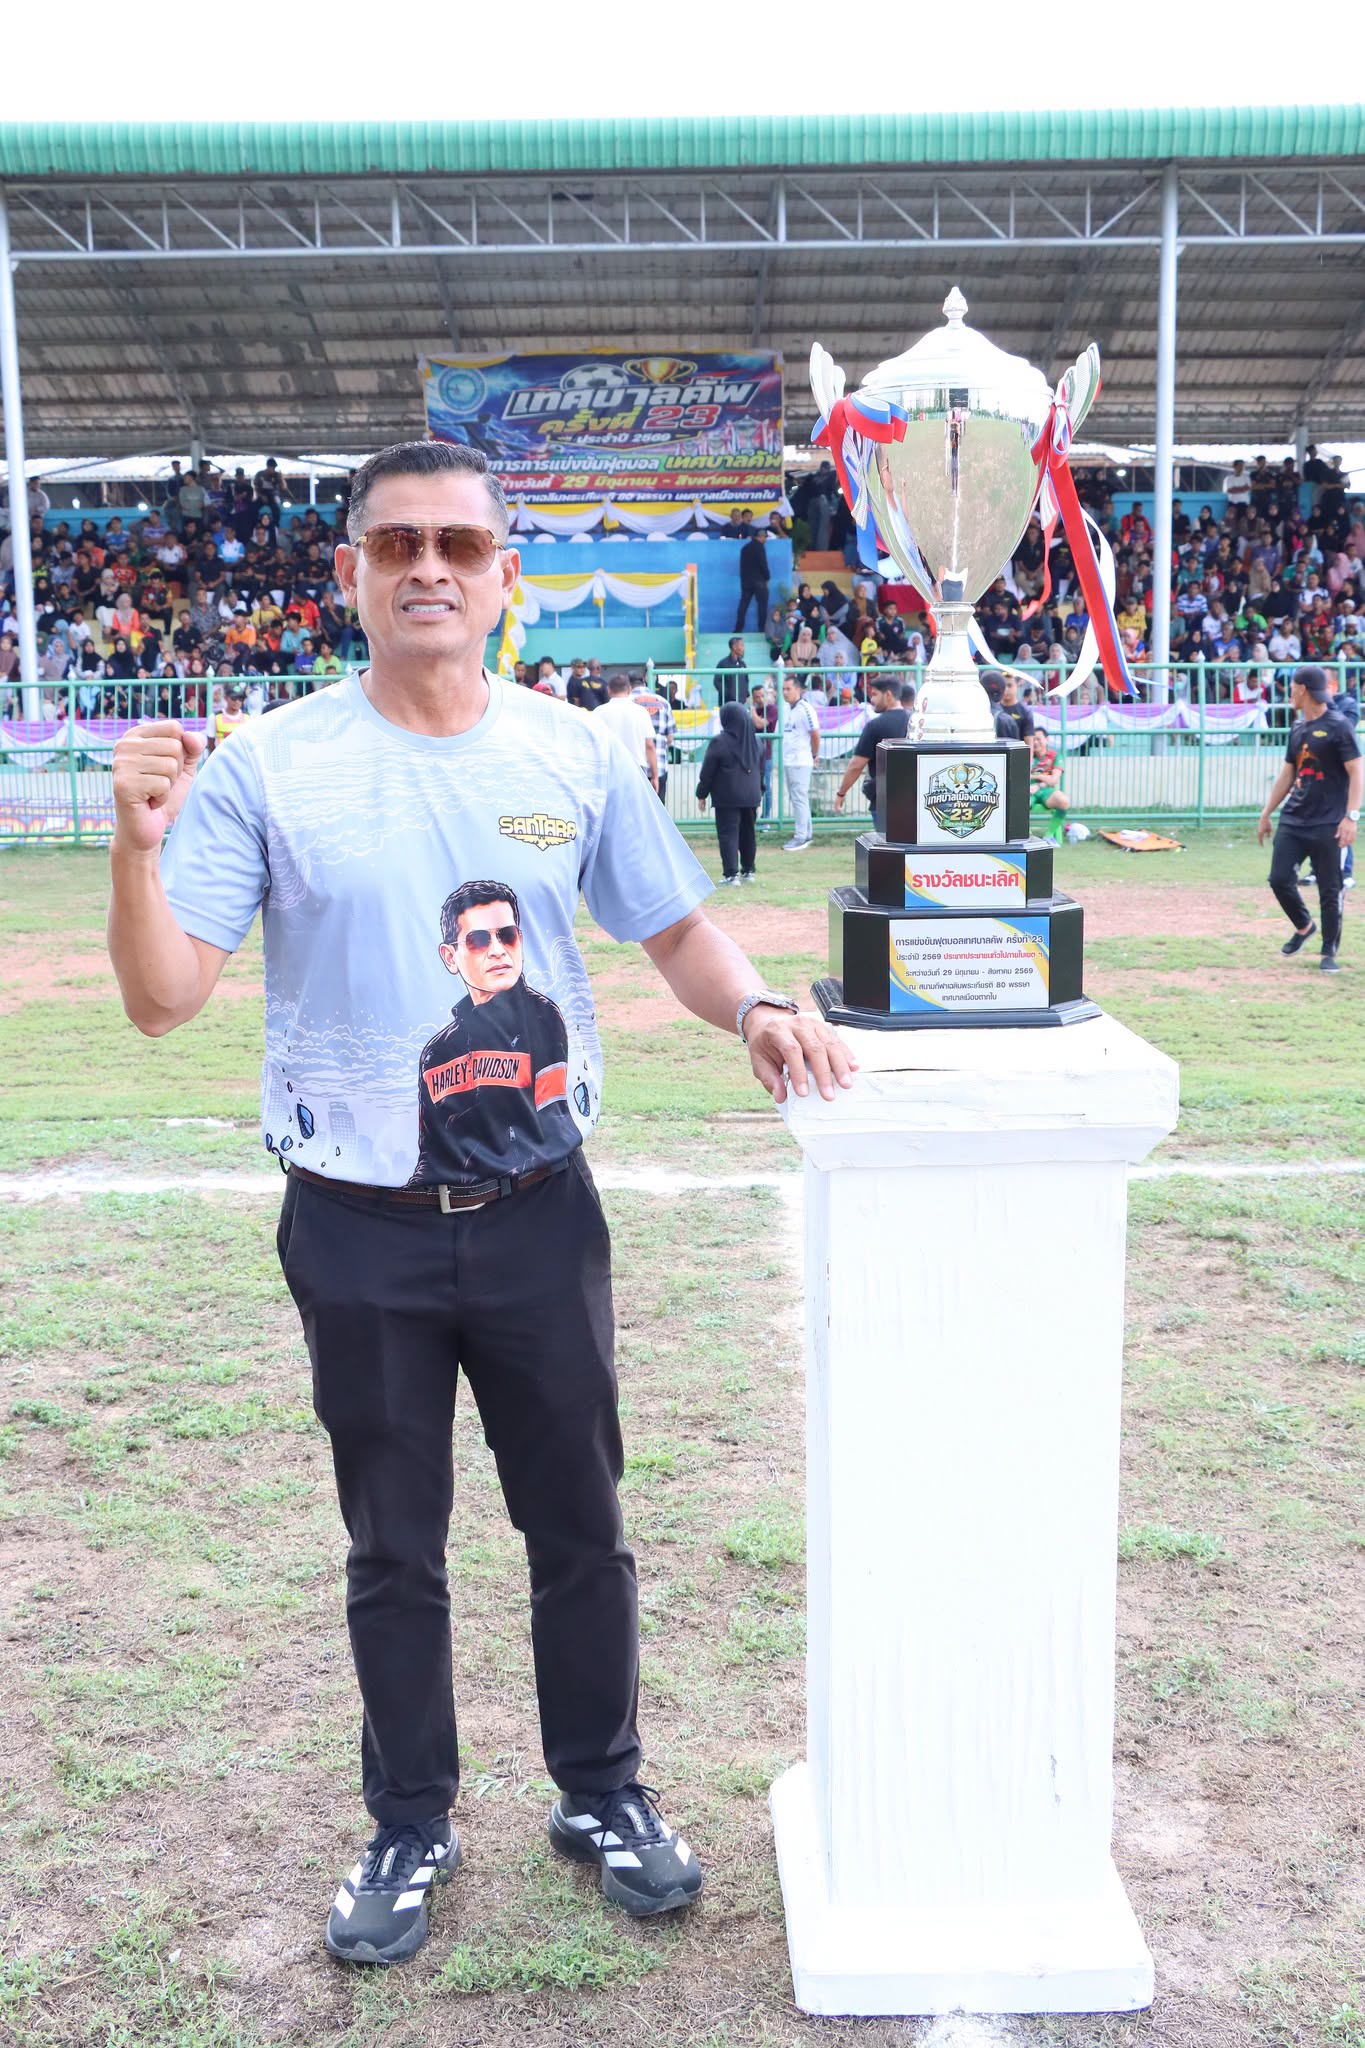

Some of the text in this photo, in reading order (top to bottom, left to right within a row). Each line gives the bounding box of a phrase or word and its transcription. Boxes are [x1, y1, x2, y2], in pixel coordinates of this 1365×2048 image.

[511, 377, 753, 414] เทศบาลคัพ
[537, 405, 721, 434] ครั้งที่ 23
[487, 455, 660, 475] การการแข่งขันฟุตบอล
[560, 475, 590, 489] 29
[950, 808, 974, 821] 23
[498, 813, 577, 840] SANTARA
[912, 869, 1020, 888] รางวัลชนะเลิศ
[1031, 935, 1044, 943] 23
[922, 953, 942, 961] 2569
[1014, 967, 1034, 975] 2569
